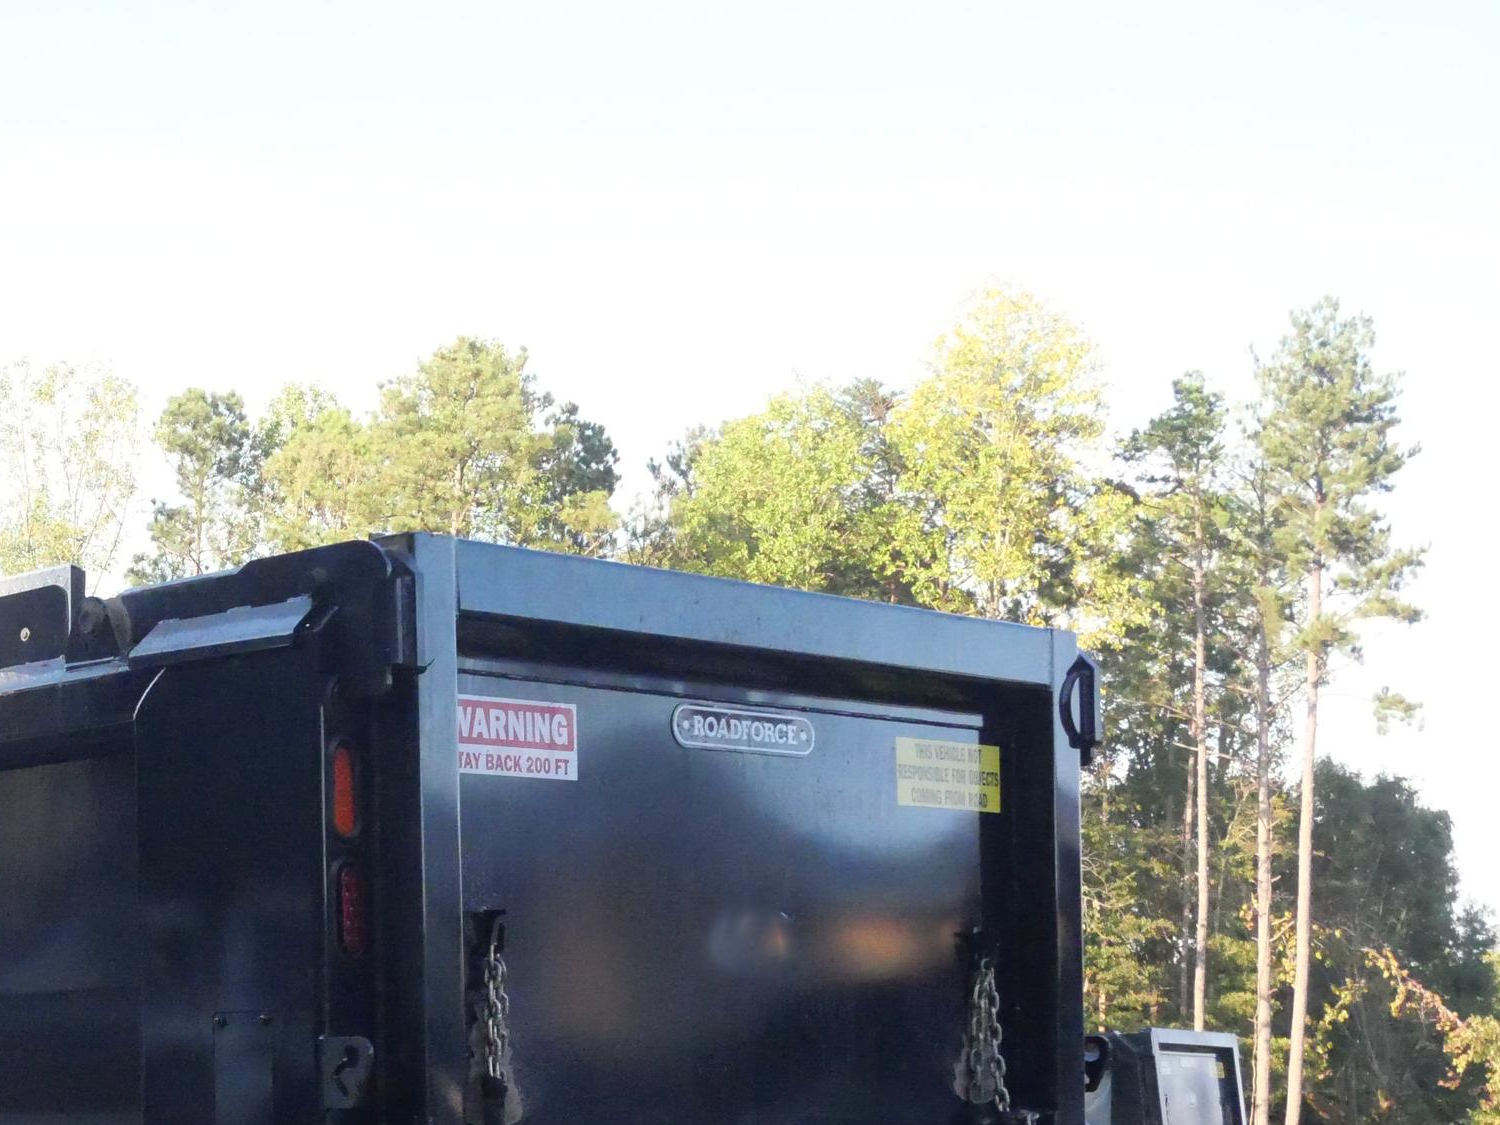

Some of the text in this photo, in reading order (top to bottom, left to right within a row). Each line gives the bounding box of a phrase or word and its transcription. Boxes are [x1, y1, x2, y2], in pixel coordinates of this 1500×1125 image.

[458, 705, 568, 745] WARNING
[692, 715, 798, 745] ROADFORCE
[458, 751, 570, 776] TAY BACK 200 FT
[969, 770, 999, 788] OBJECTS
